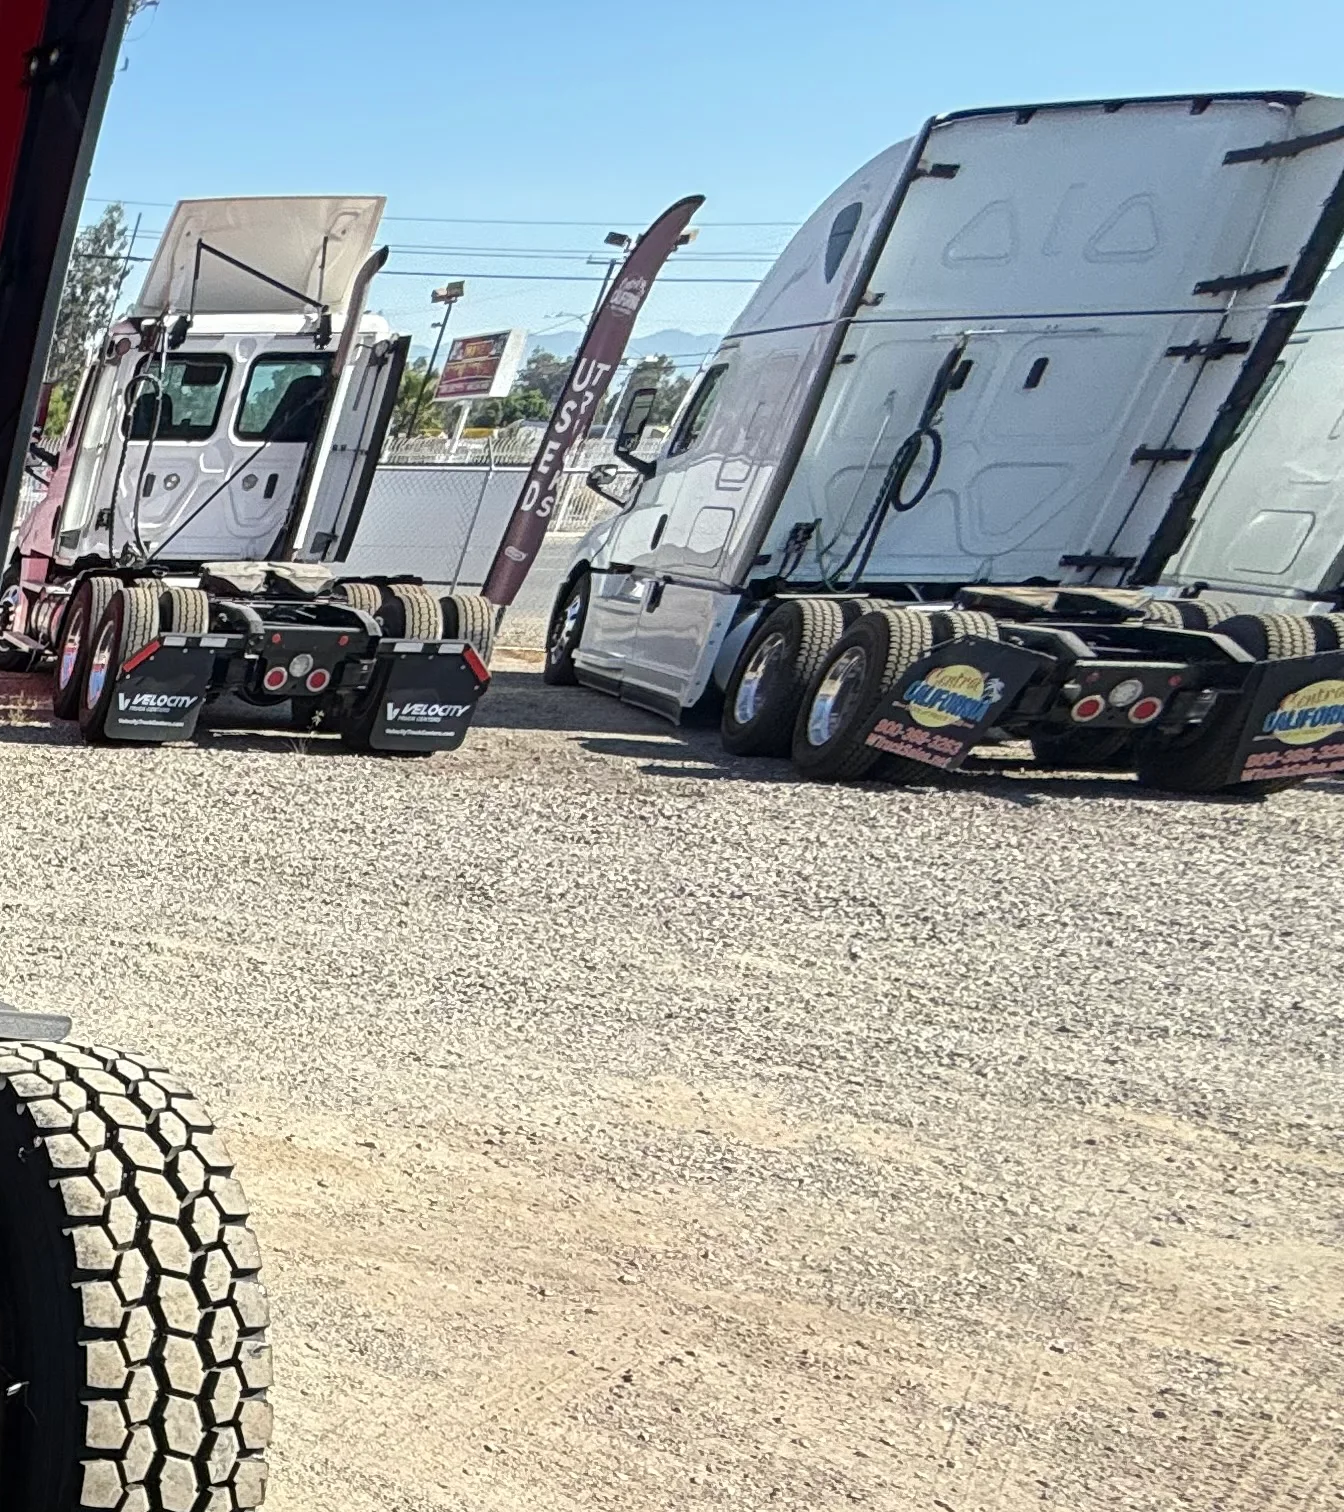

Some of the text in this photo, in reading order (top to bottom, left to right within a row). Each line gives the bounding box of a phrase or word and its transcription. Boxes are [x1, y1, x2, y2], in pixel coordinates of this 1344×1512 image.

[521, 358, 596, 511] USED
[536, 363, 611, 517] TRKS
[132, 693, 198, 708] VELOCITY
[401, 703, 471, 717] VELOCITY
